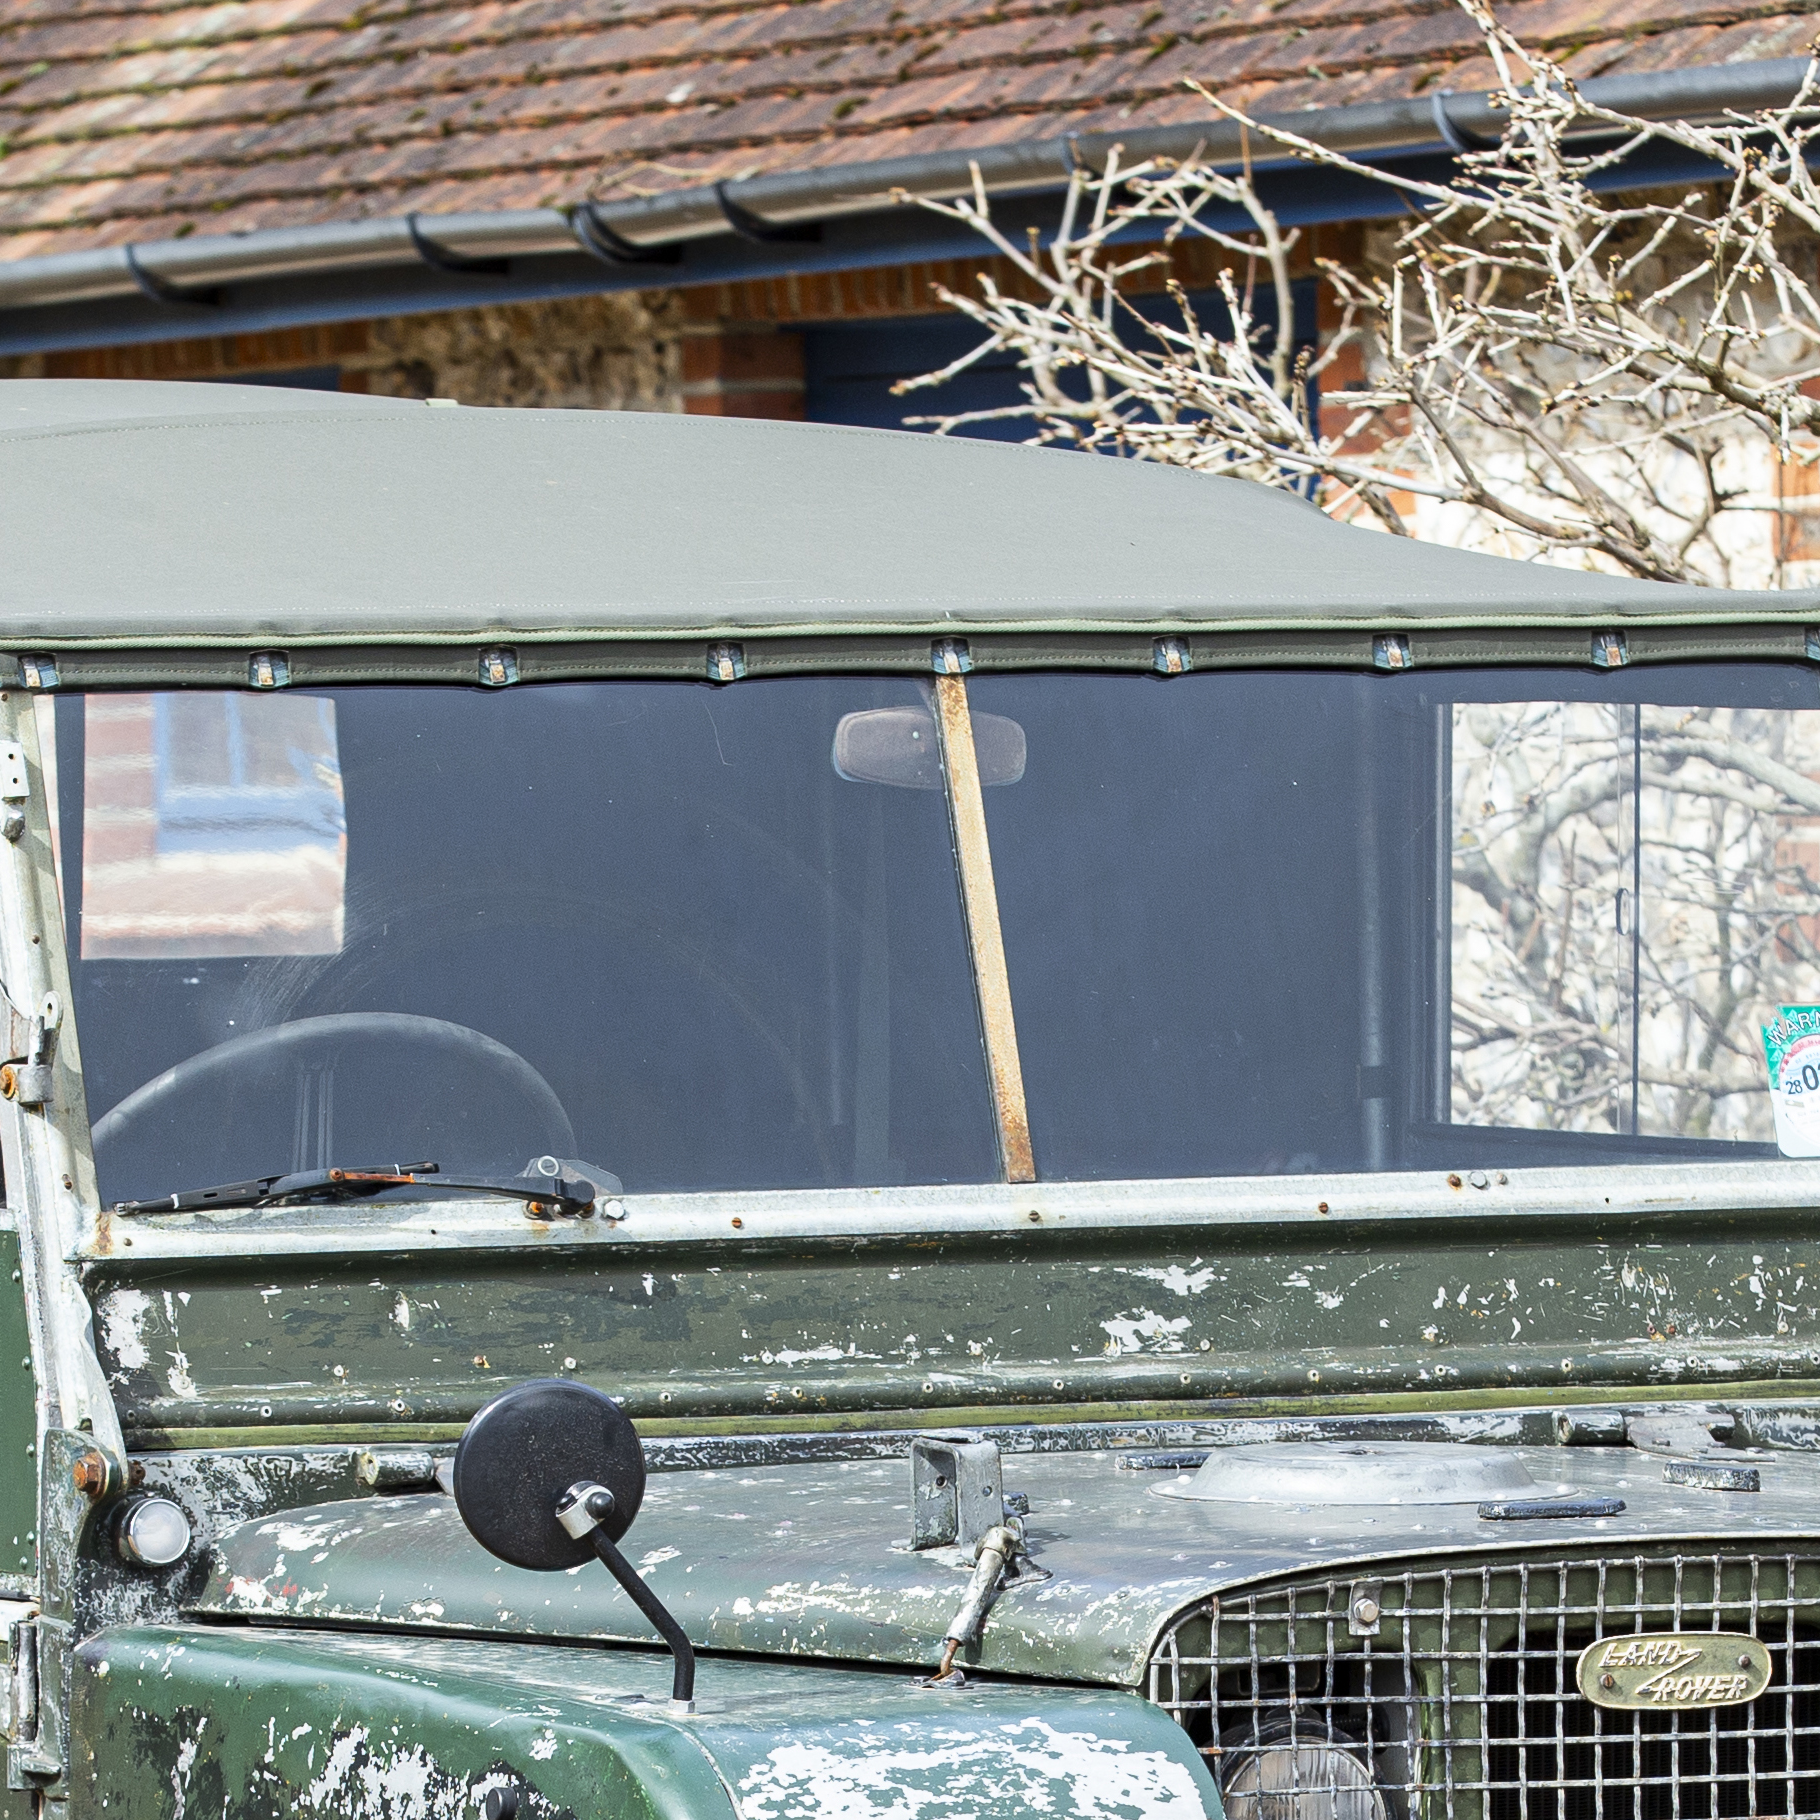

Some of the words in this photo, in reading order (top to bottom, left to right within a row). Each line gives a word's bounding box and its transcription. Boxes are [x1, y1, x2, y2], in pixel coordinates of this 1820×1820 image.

[1785, 1079, 1803, 1095] 28
[1598, 1640, 1684, 1668] LAND
[1651, 1674, 1749, 1702] ROVER
